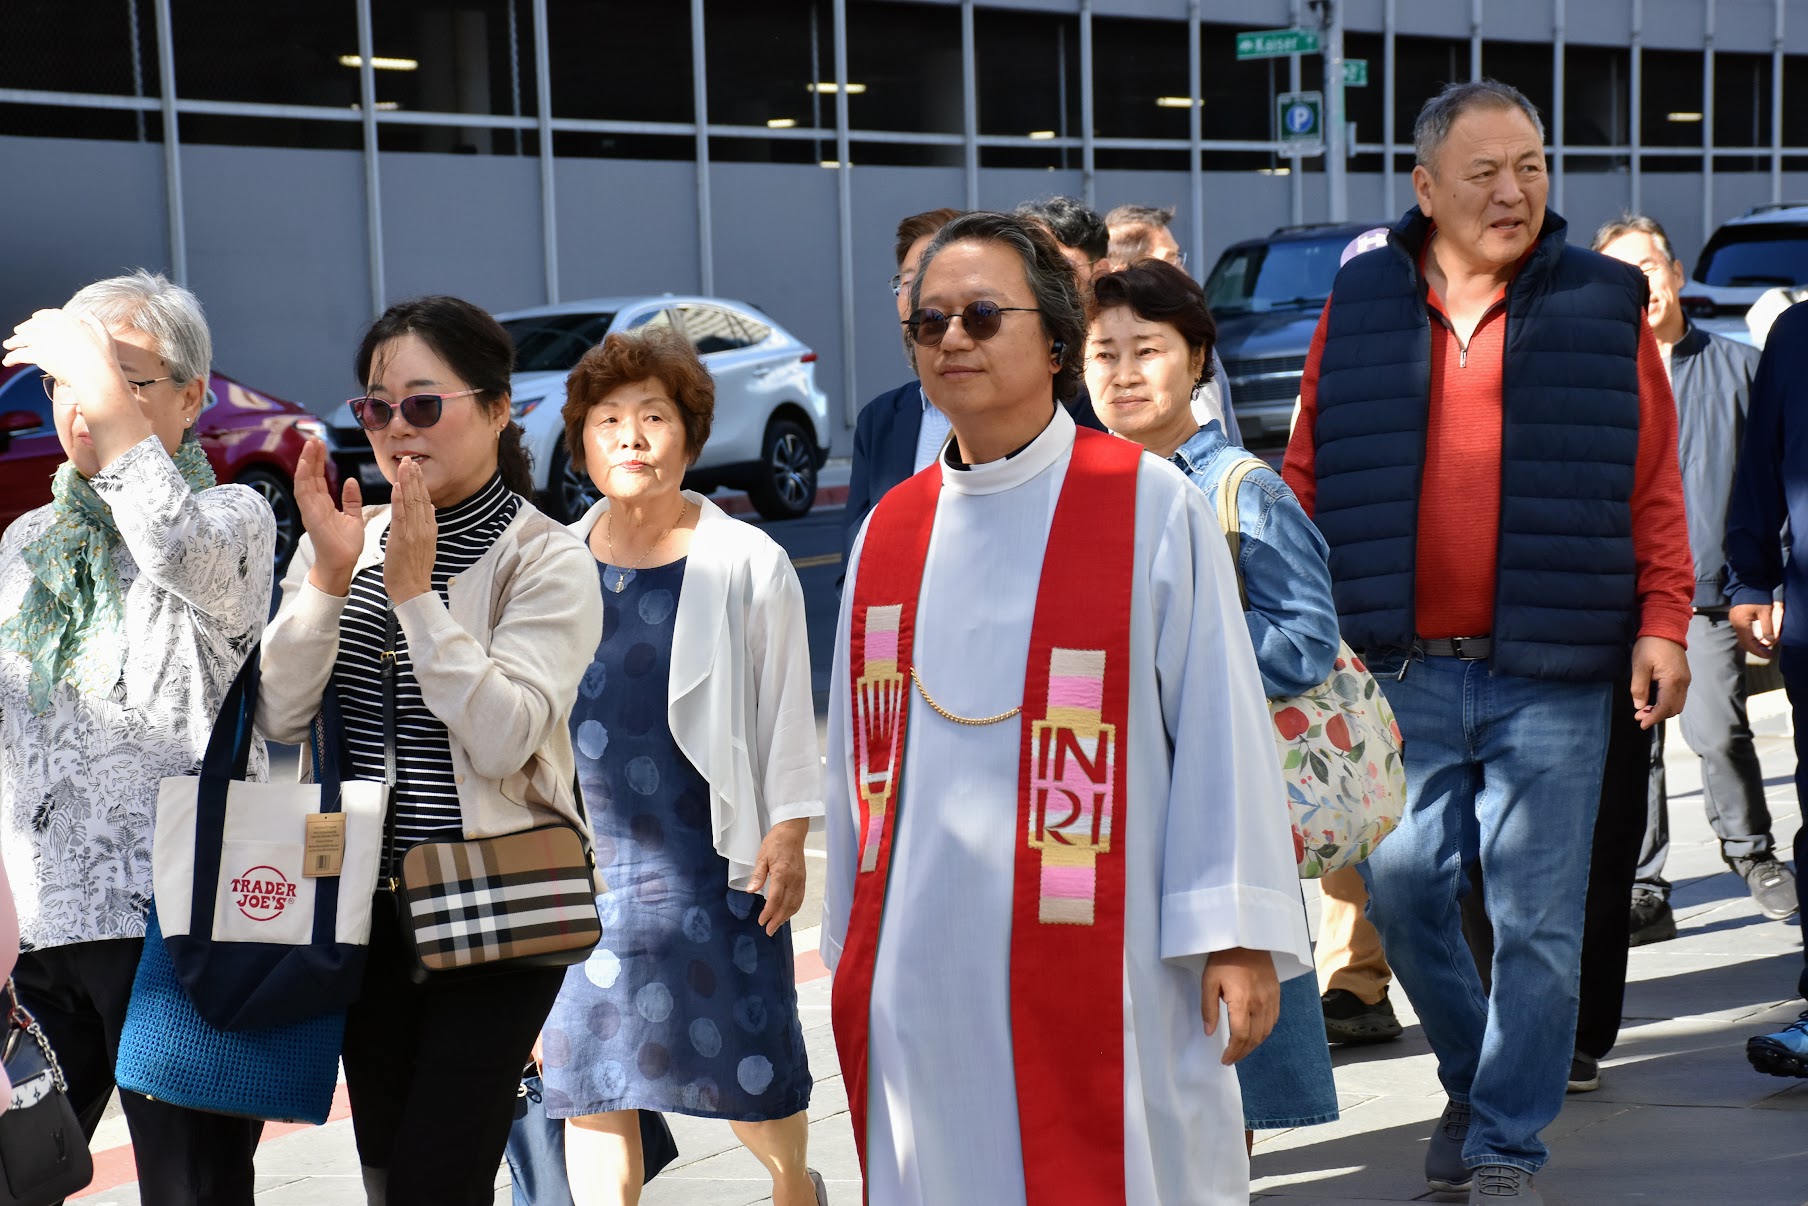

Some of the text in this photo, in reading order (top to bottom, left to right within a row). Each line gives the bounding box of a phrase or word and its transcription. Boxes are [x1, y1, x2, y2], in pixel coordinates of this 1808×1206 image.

[1255, 37, 1297, 52] Kaiser
[1293, 105, 1310, 131] P
[1038, 727, 1108, 784] IN
[1035, 788, 1107, 846] RI
[230, 878, 297, 897] TRADER
[236, 894, 287, 910] JOE'S
